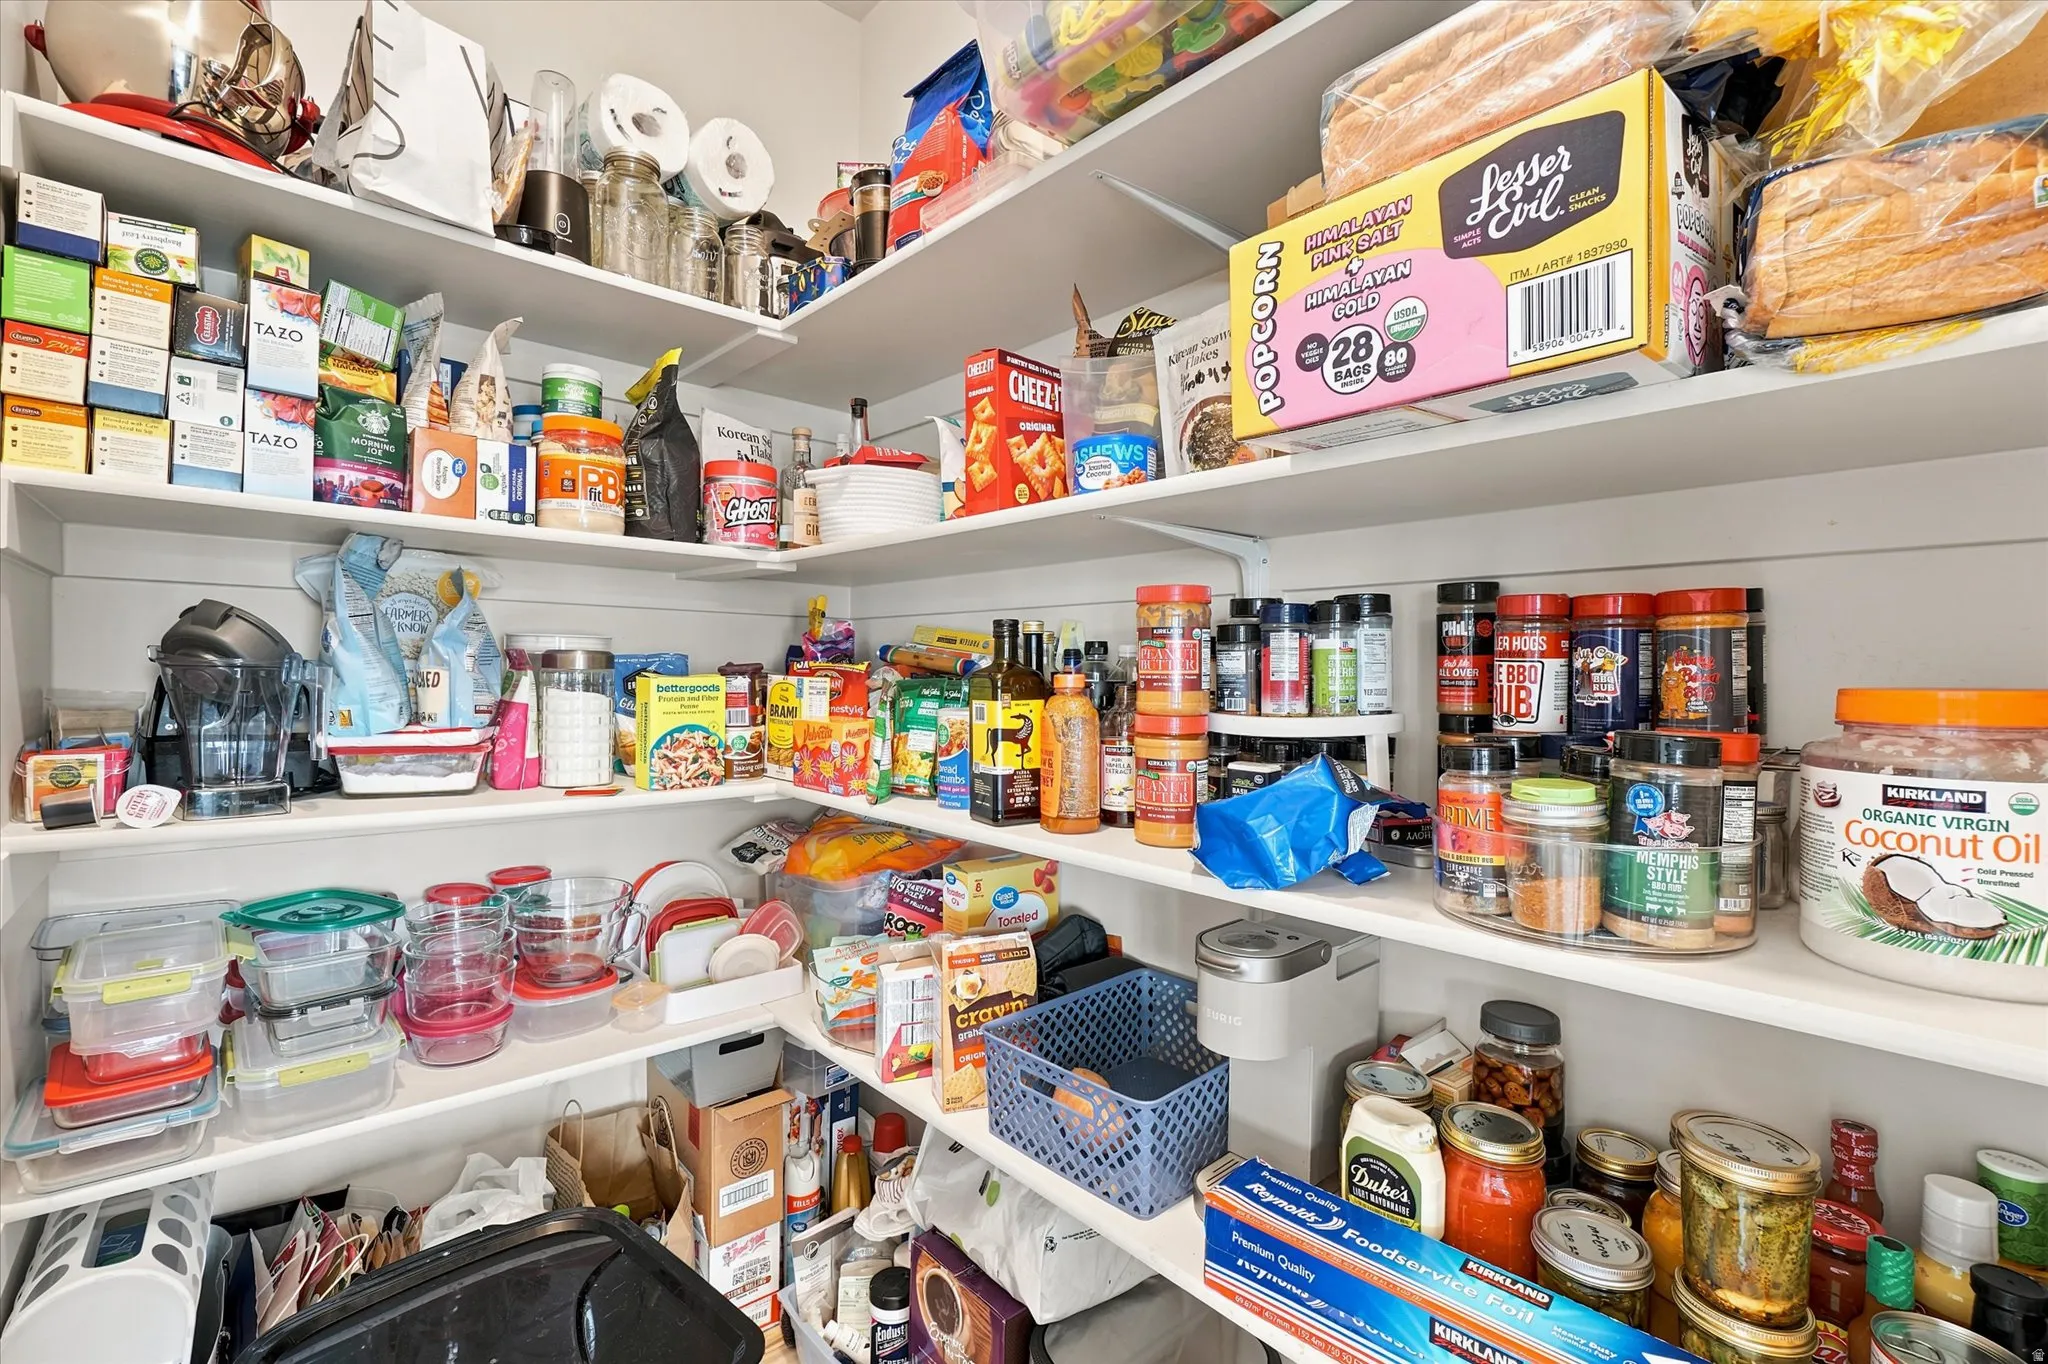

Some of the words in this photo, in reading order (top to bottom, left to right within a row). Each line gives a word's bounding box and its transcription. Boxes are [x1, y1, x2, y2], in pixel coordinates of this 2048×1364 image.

[1466, 145, 1573, 226] Lesser
[1568, 186, 1600, 203] CLEAN
[1568, 193, 1607, 212] SNACKS
[1304, 195, 1412, 254] HIMALAYAN
[1453, 228, 1482, 243] SIMPLE
[1461, 236, 1482, 249] ACTS
[1311, 239, 1354, 272] PINK
[1356, 220, 1404, 255] SALT
[1510, 268, 1533, 282] ITM.
[1541, 254, 1574, 272] ART#
[1577, 238, 1628, 261] 1837930
[1305, 259, 1412, 312] HIMALAYAN
[1332, 292, 1380, 322] GOLD
[1393, 306, 1418, 321] USDA
[254, 322, 303, 342] TAZO
[1251, 241, 1285, 416] POPCORN
[1390, 319, 1421, 334] ORGANIC
[1307, 342, 1318, 350] NO
[1532, 338, 1564, 353] 58906
[1569, 328, 1604, 344] 00473
[1168, 341, 1198, 367] Korean
[1300, 347, 1324, 358] VEGGIE
[1331, 330, 1374, 369] 28
[1384, 347, 1408, 367] 80
[1185, 347, 1219, 370] Flakes
[1305, 355, 1320, 365] OILS
[1333, 363, 1371, 383] BAGS
[1340, 377, 1365, 389] INSIDE
[1019, 421, 1056, 432] ORIGINAL
[249, 432, 298, 449] TAZO
[351, 437, 396, 453] MORNING
[717, 426, 760, 444] Korean
[762, 434, 772, 448] Se
[366, 447, 383, 456] JOE
[1074, 443, 1144, 465] ASHEWS
[589, 487, 602, 503] fit
[725, 496, 777, 525] GHOST
[385, 606, 433, 623] FARMERS
[397, 622, 429, 635] KNOW
[1513, 636, 1547, 651] HOGS
[1140, 648, 1196, 659] PEANUT
[1140, 659, 1195, 670] BUTTER
[1439, 668, 1450, 677] ALL
[1452, 668, 1479, 677] OVER
[1506, 664, 1538, 684] BBQ
[1592, 674, 1614, 682] BBQ
[656, 684, 721, 694] bettergoods
[1592, 683, 1615, 691] RUB
[769, 703, 798, 719] BRAMI
[1137, 778, 1189, 791] PEANUT
[1137, 790, 1188, 802] BUTTER
[1887, 786, 1983, 804] KIRKLAND
[1862, 807, 1937, 828] ORGANIC
[1943, 815, 2010, 833] VIRGIN
[1845, 819, 1984, 861] Coconut
[1993, 832, 2040, 864] Oil
[1636, 851, 1699, 870] MEMPHIS
[1646, 868, 1689, 885] STYLE
[1977, 867, 1997, 876] Cold
[1999, 869, 2035, 879] Pressed
[906, 882, 935, 896] VARIETY
[975, 882, 982, 893] 8
[1652, 883, 1667, 891] BBQ
[1668, 884, 1682, 893] RUB
[1977, 878, 2020, 888] Unrefined
[904, 889, 925, 901] PACK
[995, 890, 1014, 901] Great
[998, 910, 1038, 928] Toasted
[1206, 1008, 1242, 1026] EURIG
[958, 1029, 984, 1042] graha
[1261, 1170, 1302, 1195] Premium
[1304, 1190, 1341, 1213] Quality
[1350, 1164, 1409, 1203] Duke's
[1352, 1186, 1369, 1200] LIGHT
[1370, 1193, 1410, 1217] MAYONNAISE
[1812, 1228, 1834, 1241] OT
[1232, 1230, 1275, 1263] Premium
[1277, 1255, 1316, 1284] Quality
[1245, 1182, 1324, 1226] Reynolds
[1342, 1228, 1478, 1299] Foodservice
[1484, 1293, 1535, 1325] Foil
[1466, 1260, 1550, 1304] KIRKLAND
[877, 1325, 906, 1342] Endust
[1551, 1330, 1593, 1354] Aluminum
[1552, 1324, 1587, 1343] Heavy
[1588, 1340, 1618, 1360] Duty
